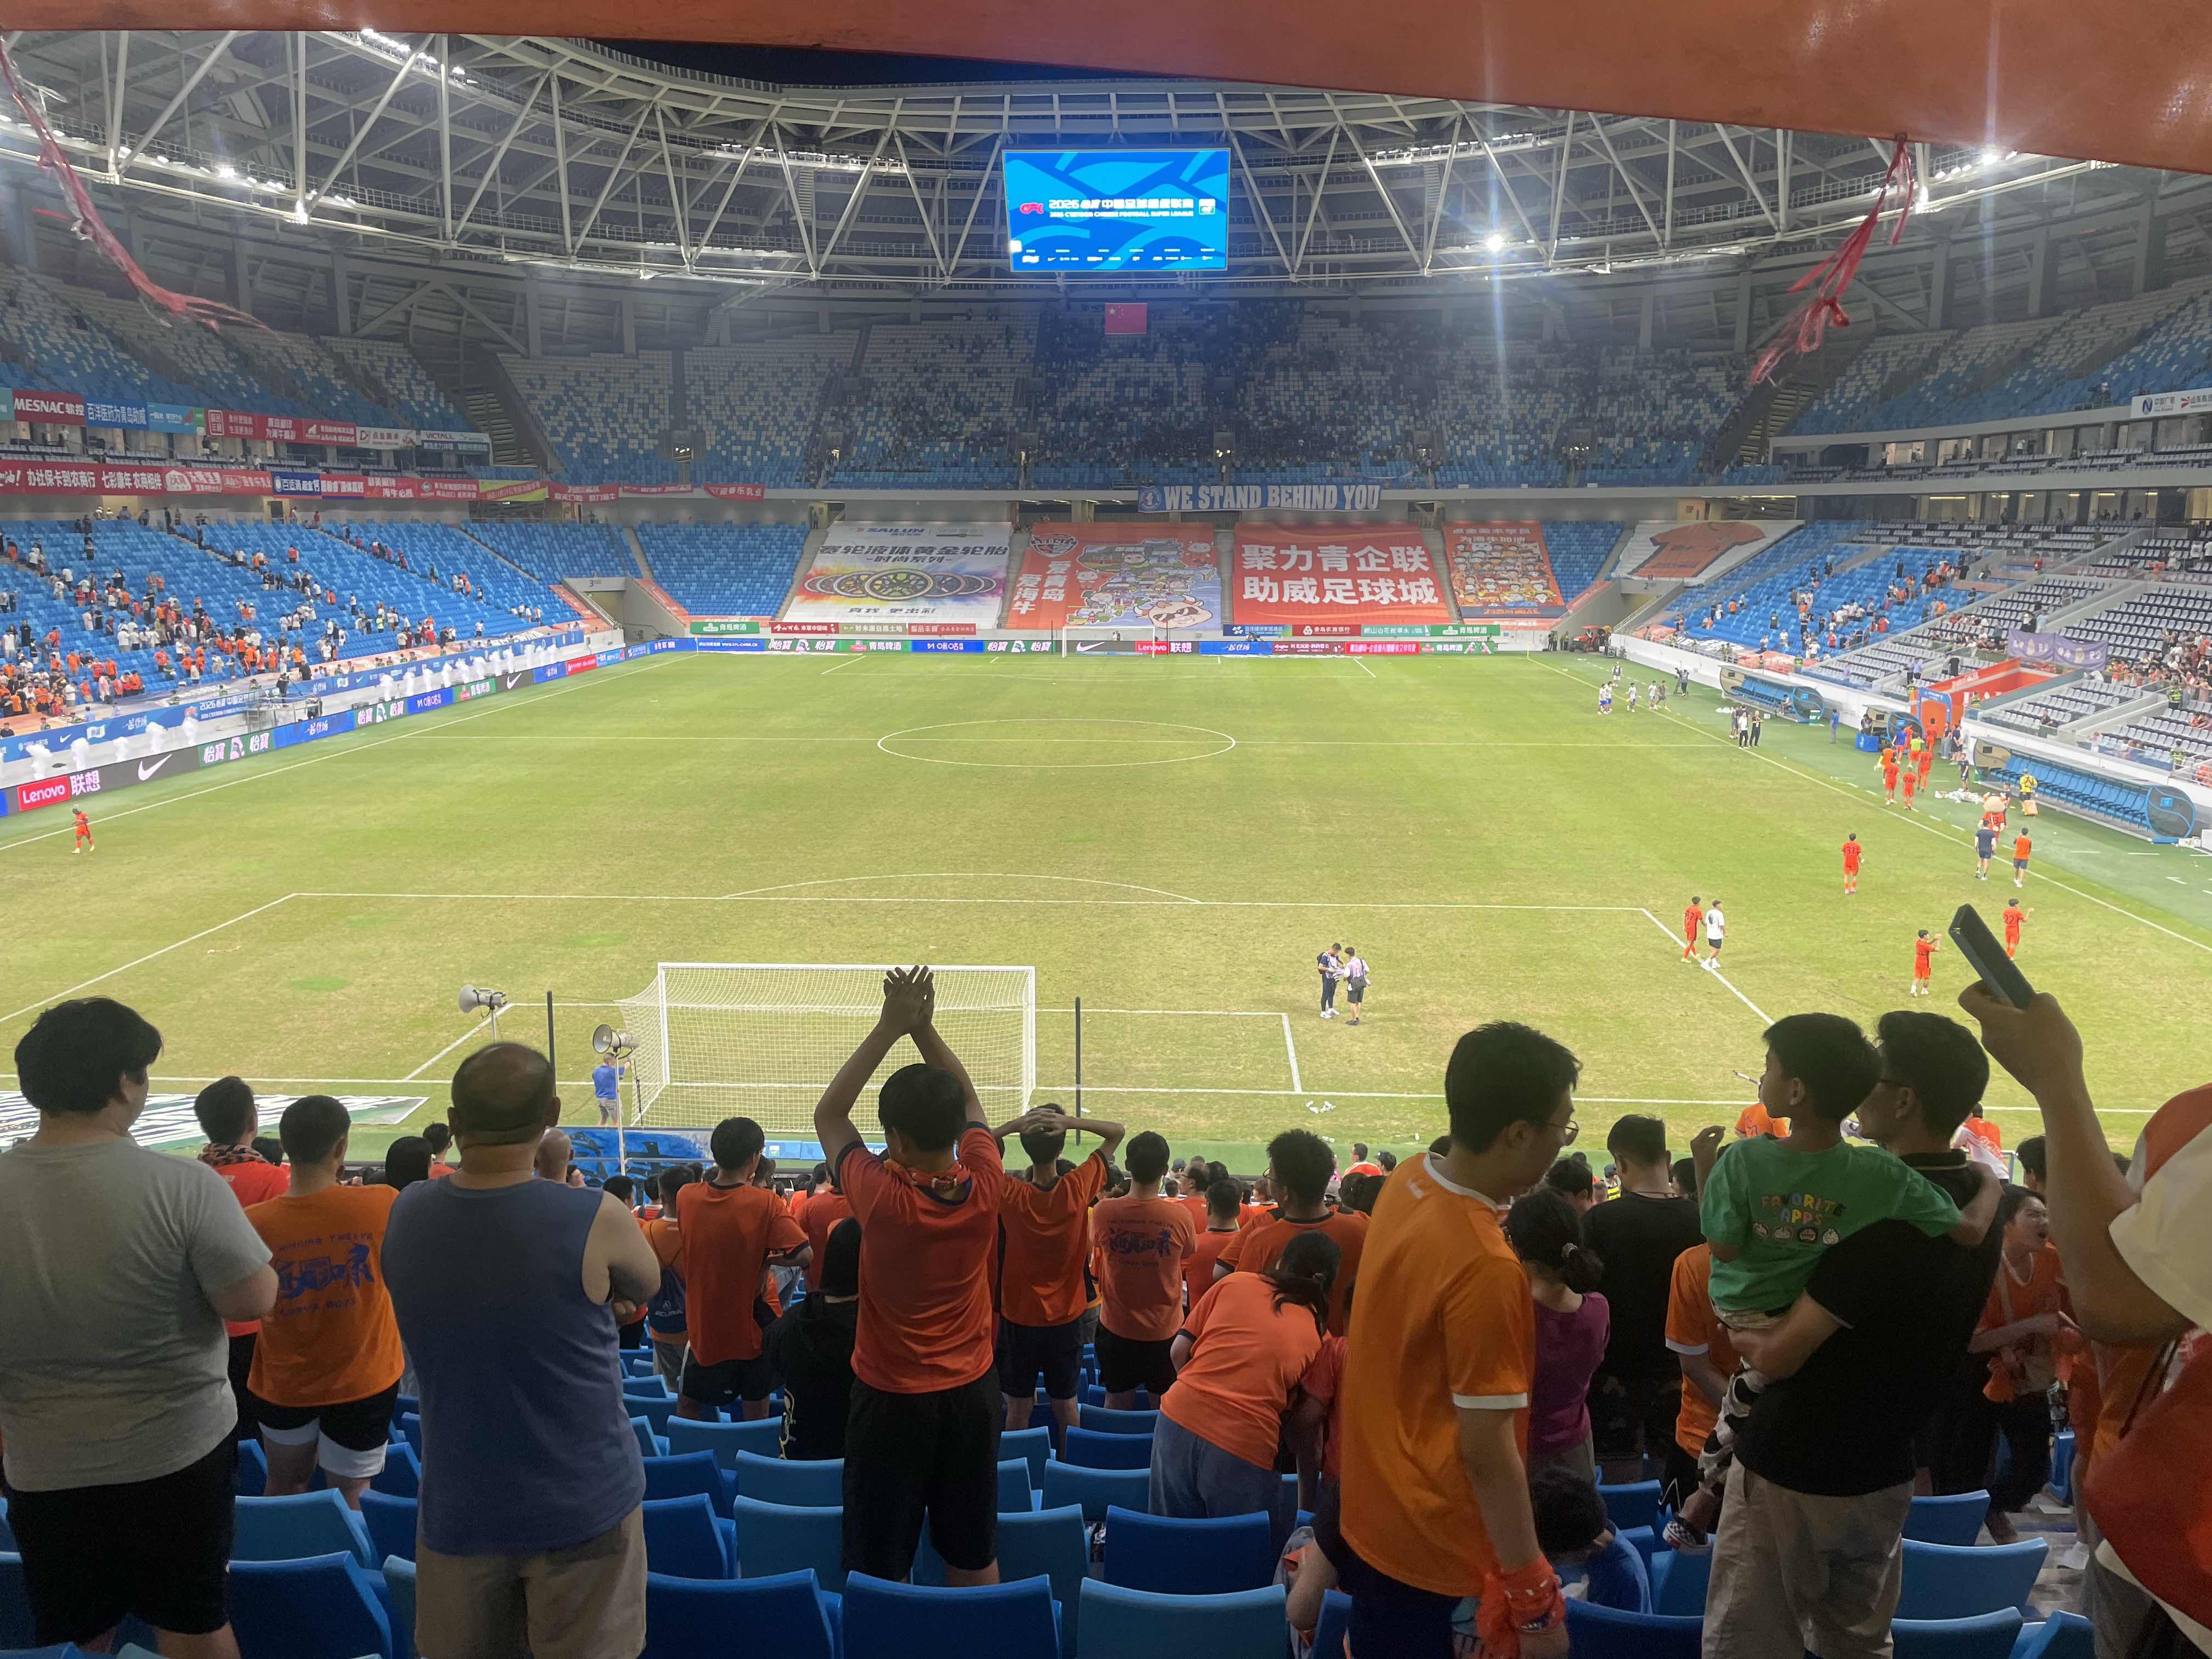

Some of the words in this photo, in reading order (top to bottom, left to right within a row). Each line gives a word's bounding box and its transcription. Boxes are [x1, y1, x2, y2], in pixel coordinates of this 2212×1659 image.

[14, 398, 65, 414] MESNAC
[1164, 486, 1193, 510] WE
[1198, 485, 1262, 510] STAND
[1267, 484, 1338, 510] BEHIND
[1342, 484, 1380, 511] YOU
[820, 544, 1009, 556] 赛轮液体黄金轮胎
[1242, 544, 1430, 573] 聚力青企联
[1243, 576, 1440, 605] 助威足球城
[1170, 642, 1192, 653] 联想
[70, 769, 101, 796] 联想
[22, 783, 66, 804] Lenovo
[2004, 915, 2015, 925] 22
[1761, 1193, 1846, 1216] FAVORITE
[1781, 1208, 1825, 1226] APPS
